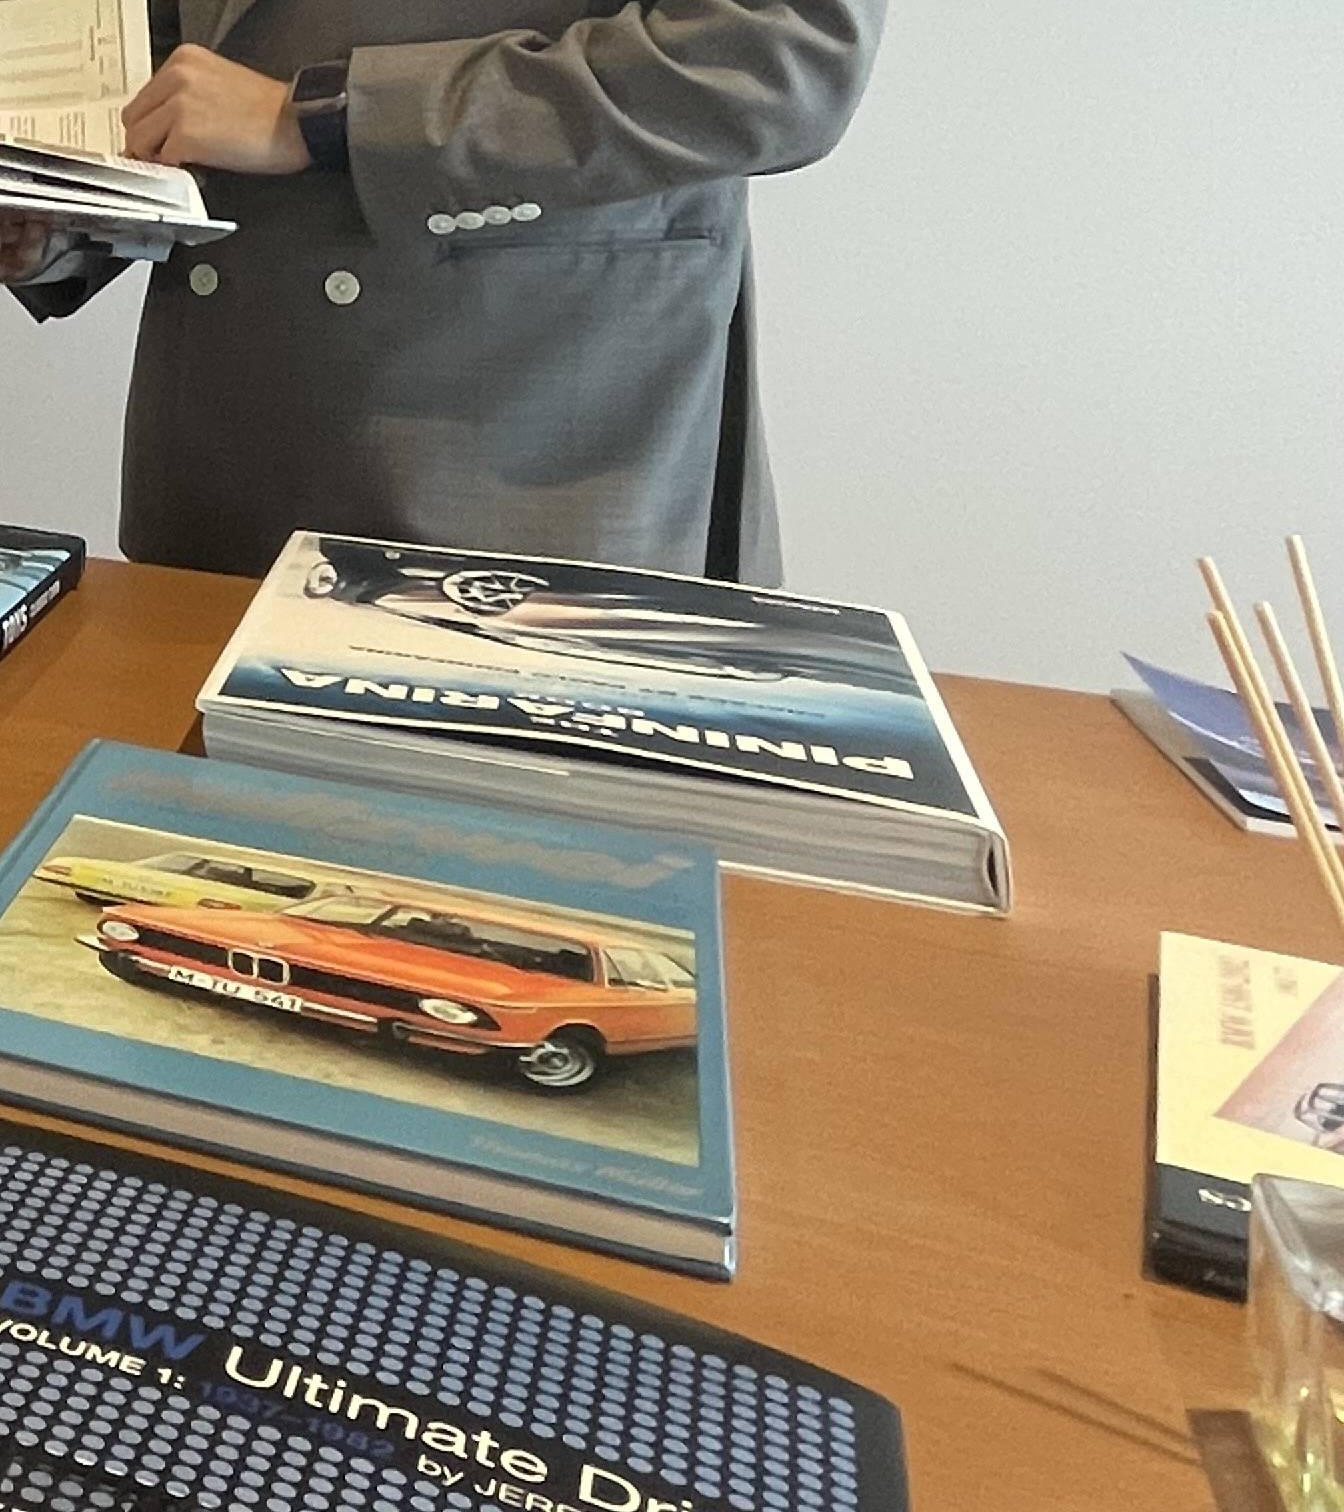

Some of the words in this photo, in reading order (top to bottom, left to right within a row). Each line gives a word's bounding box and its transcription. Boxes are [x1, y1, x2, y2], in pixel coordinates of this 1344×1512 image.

[280, 666, 915, 781] PININFARINA
[156, 1367, 187, 1390] 1:
[223, 1343, 549, 1485] Ultimate
[416, 1453, 464, 1487] by
